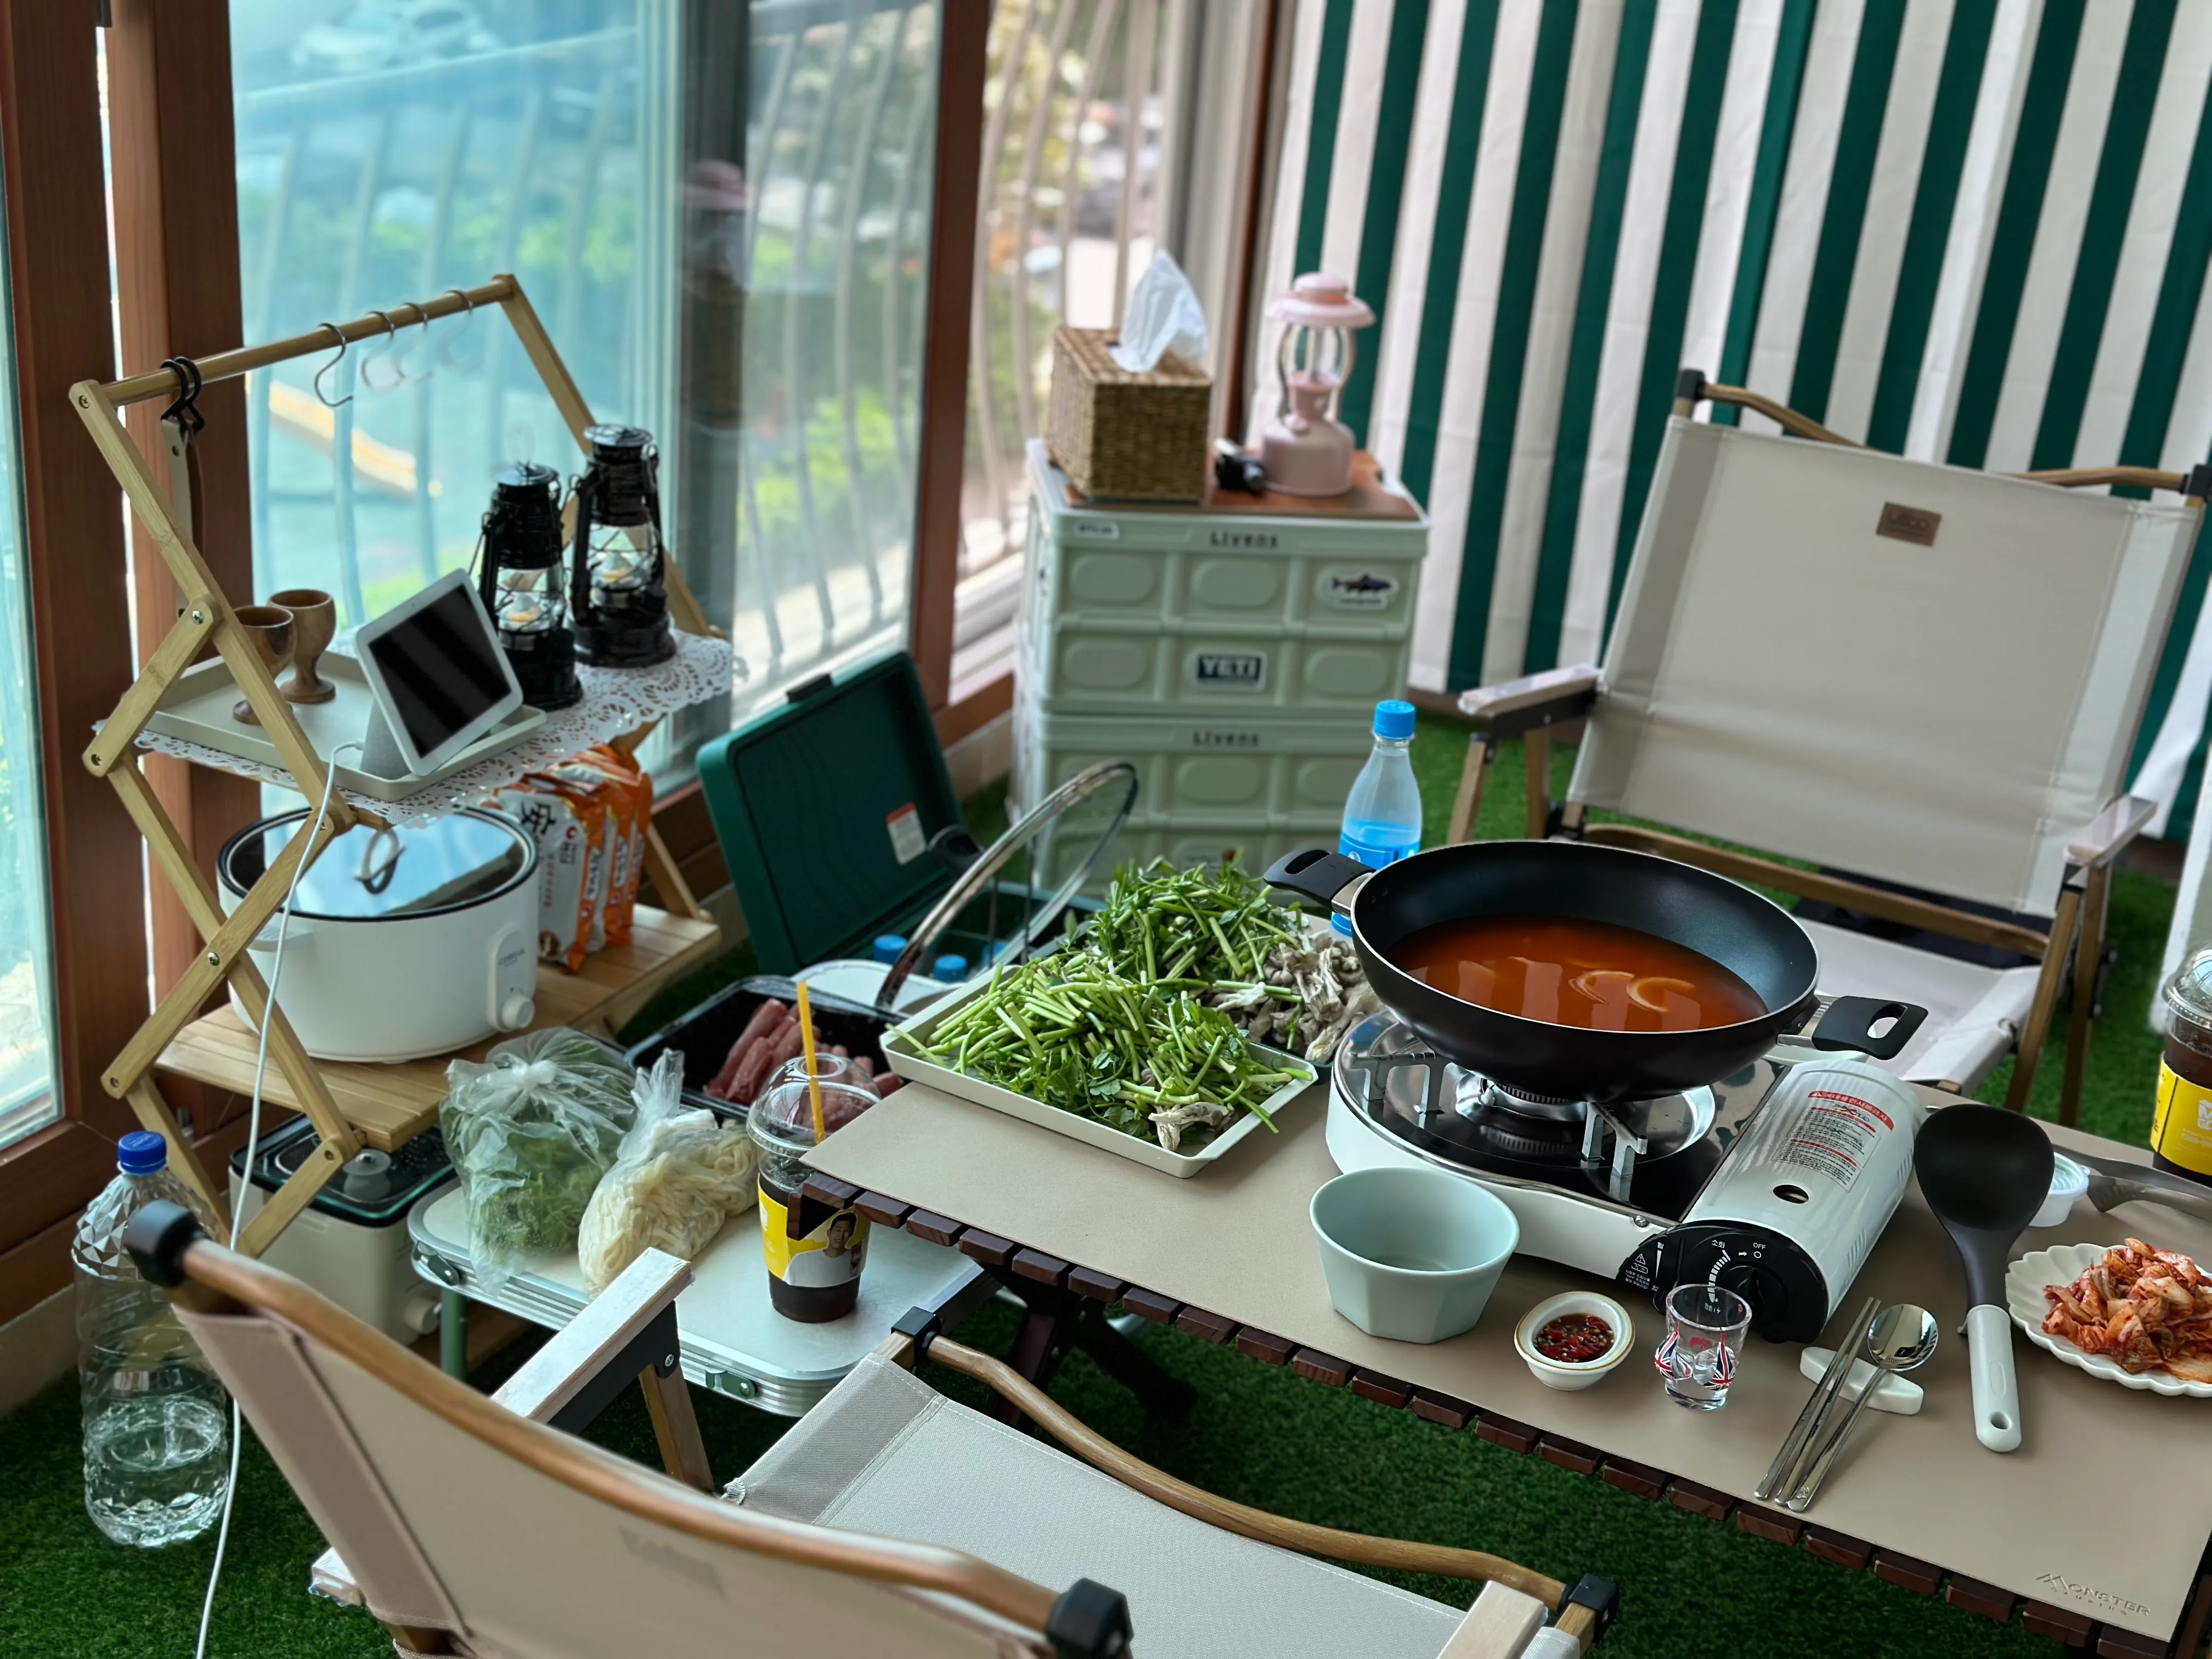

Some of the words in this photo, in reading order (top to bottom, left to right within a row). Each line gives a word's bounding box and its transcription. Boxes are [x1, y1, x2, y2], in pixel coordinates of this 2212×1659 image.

[1210, 530, 1279, 549] Livens
[1202, 657, 1257, 678] YETI
[1194, 731, 1259, 746] Livens
[1711, 1239, 1725, 1249] 소화
[2035, 1573, 2151, 1616] MONSTER
